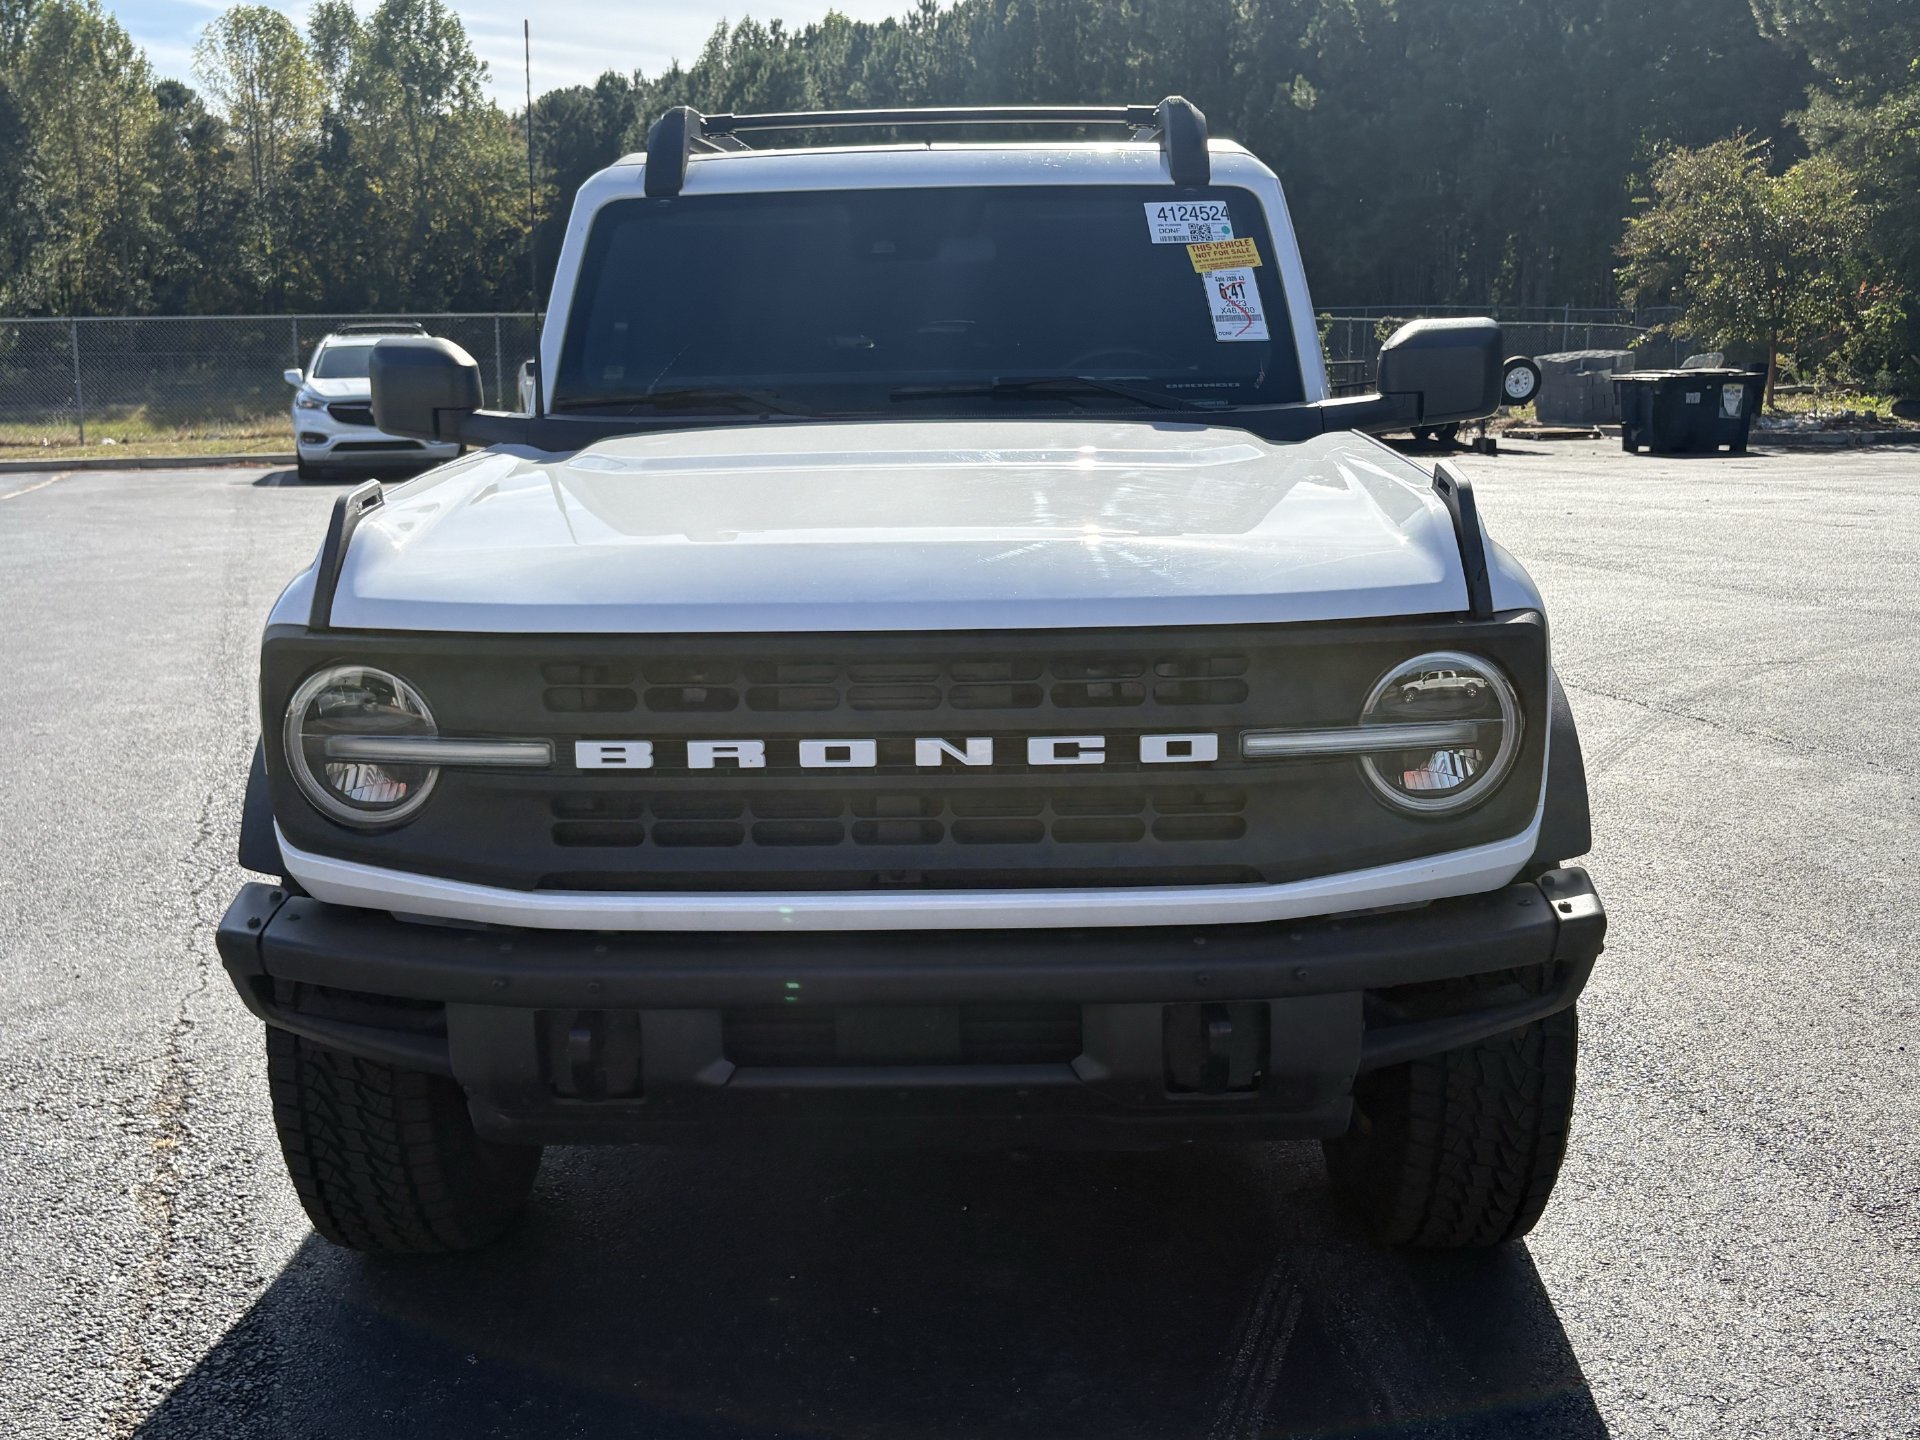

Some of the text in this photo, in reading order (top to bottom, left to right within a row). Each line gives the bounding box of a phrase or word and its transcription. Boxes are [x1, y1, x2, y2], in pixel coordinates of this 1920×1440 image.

[1157, 206, 1230, 221] 4124524
[1191, 239, 1251, 252] THIS VEHICLE
[1195, 251, 1211, 259] NOT
[1231, 247, 1251, 255] SALE
[575, 733, 1219, 769] BRONCO
